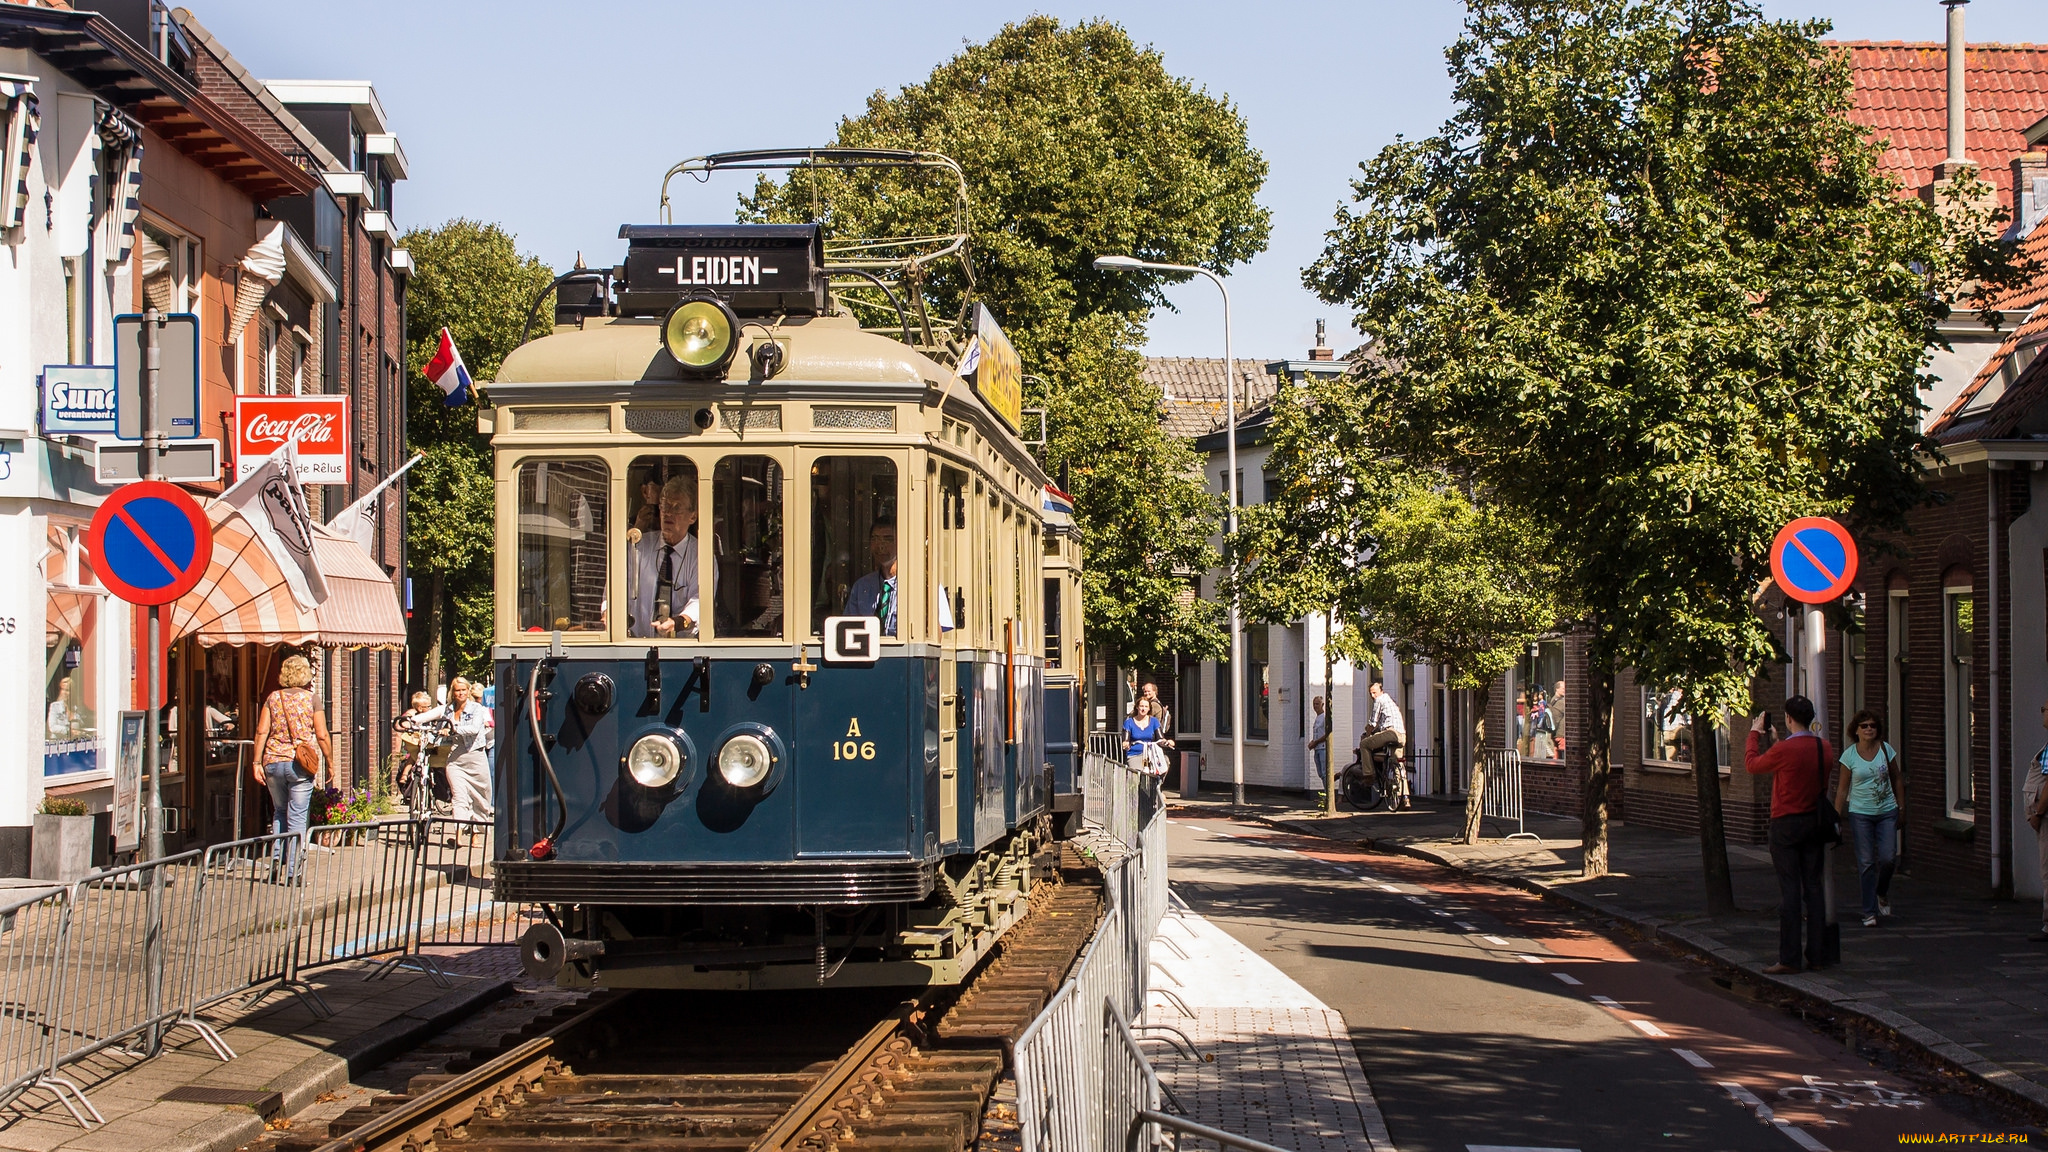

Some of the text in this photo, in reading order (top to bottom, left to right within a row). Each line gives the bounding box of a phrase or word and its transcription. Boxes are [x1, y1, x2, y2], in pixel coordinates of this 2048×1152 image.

[313, 463, 342, 473] Rêlus
[836, 620, 870, 657] G
[846, 717, 862, 737] A
[833, 741, 876, 760] 106
